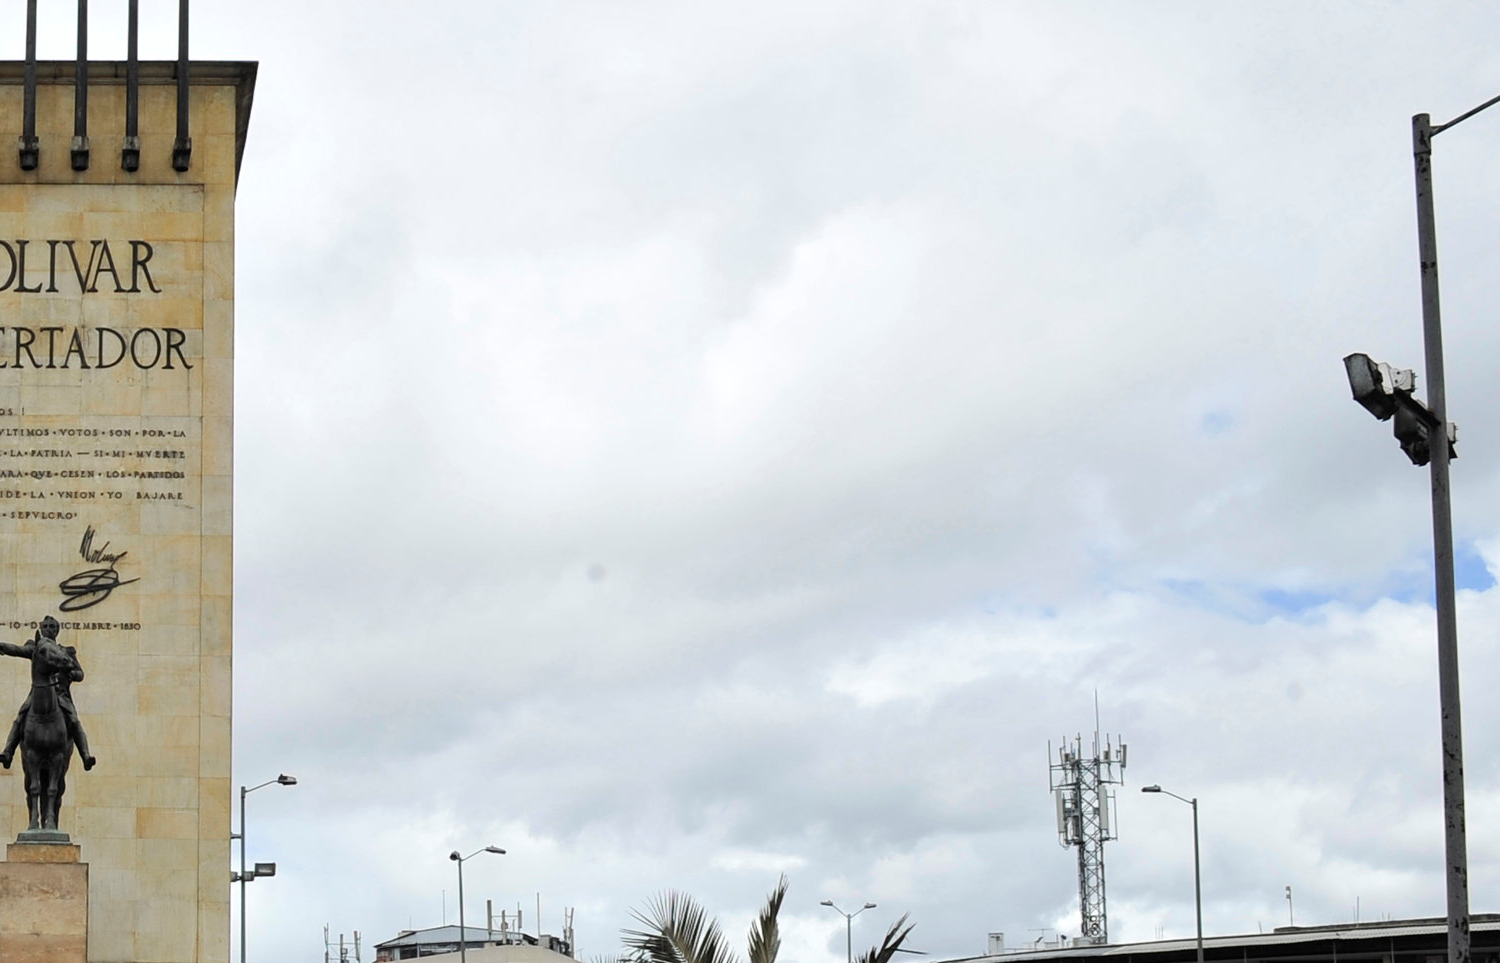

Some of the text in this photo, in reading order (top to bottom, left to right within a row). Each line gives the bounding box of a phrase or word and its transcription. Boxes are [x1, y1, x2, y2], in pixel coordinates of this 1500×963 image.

[59, 429, 98, 437] VOTOS
[109, 429, 131, 437] SON
[10, 449, 23, 457] LA
[30, 450, 72, 458] PATRIA
[112, 450, 125, 458] MI
[60, 470, 95, 478] CESEN
[106, 470, 125, 478] LOS
[134, 471, 186, 479] PARTIDOS
[30, 491, 45, 499] LA
[107, 491, 123, 499] YO
[136, 492, 184, 500] BAJARE
[60, 621, 112, 630] ICIEMBRE
